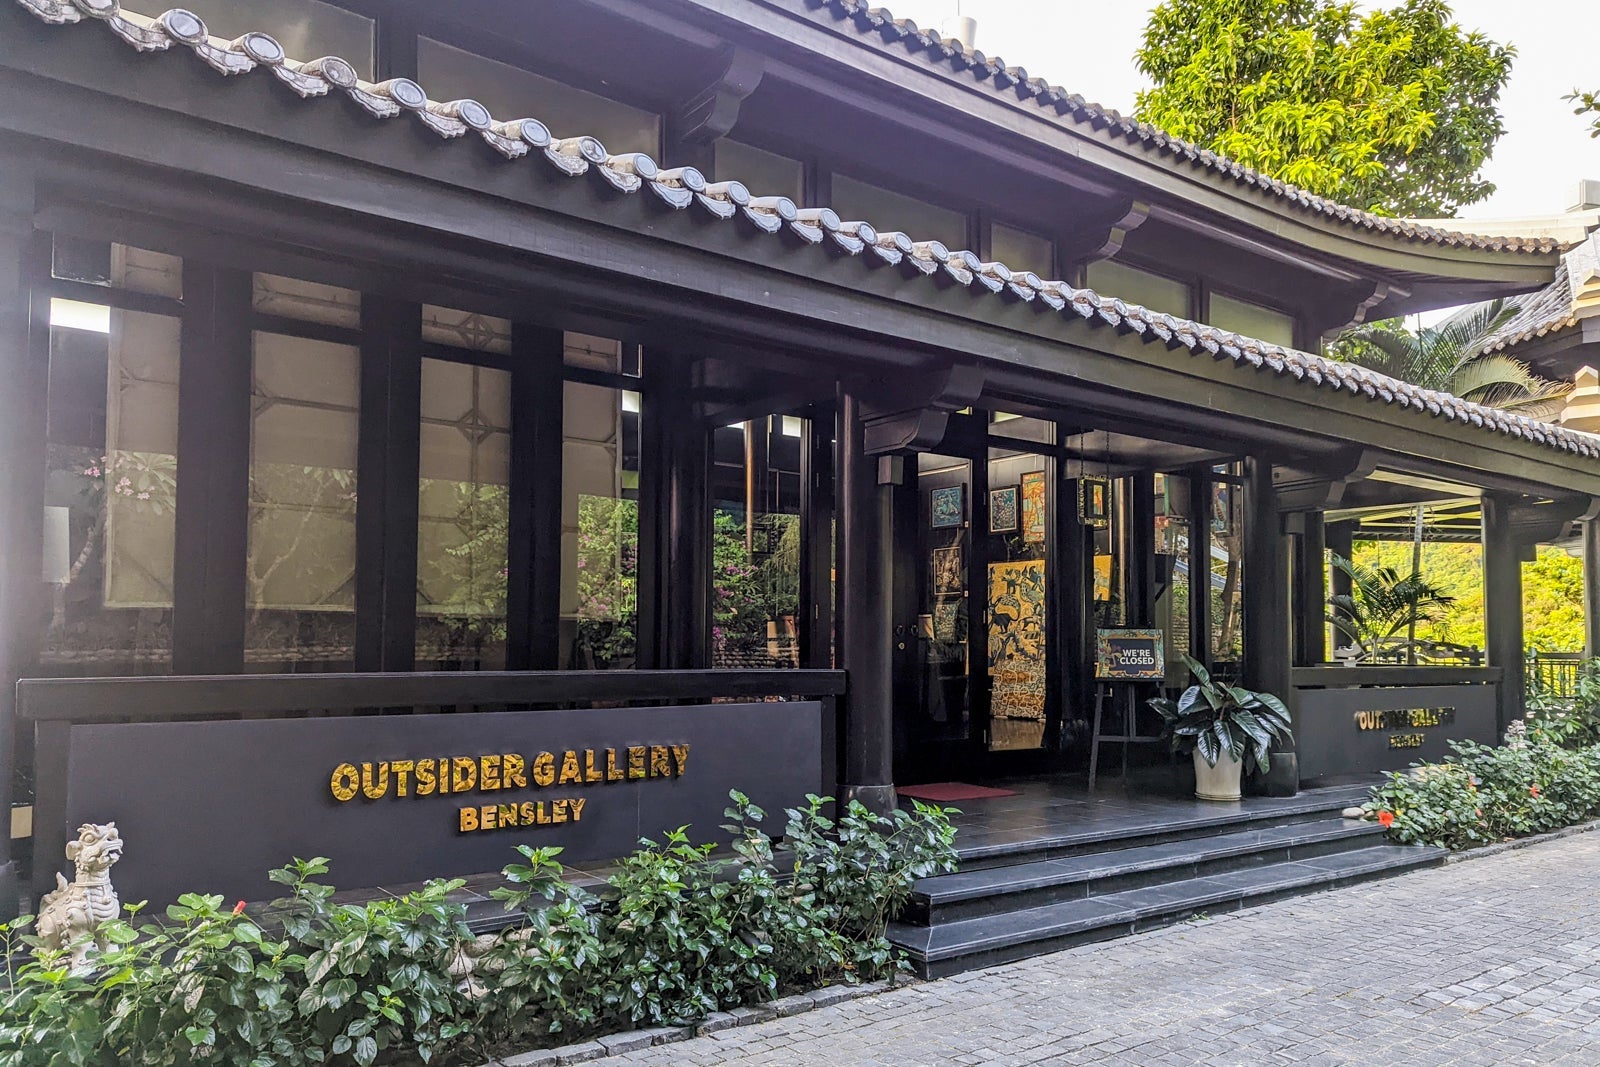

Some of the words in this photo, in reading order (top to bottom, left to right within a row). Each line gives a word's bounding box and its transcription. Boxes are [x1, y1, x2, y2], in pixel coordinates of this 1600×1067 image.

[1119, 657, 1155, 665] CLOSED
[1122, 649, 1151, 657] WE'RE
[330, 754, 527, 801] OUTSIDER
[532, 743, 690, 787] GALLERY
[459, 798, 587, 832] BENSLEY
